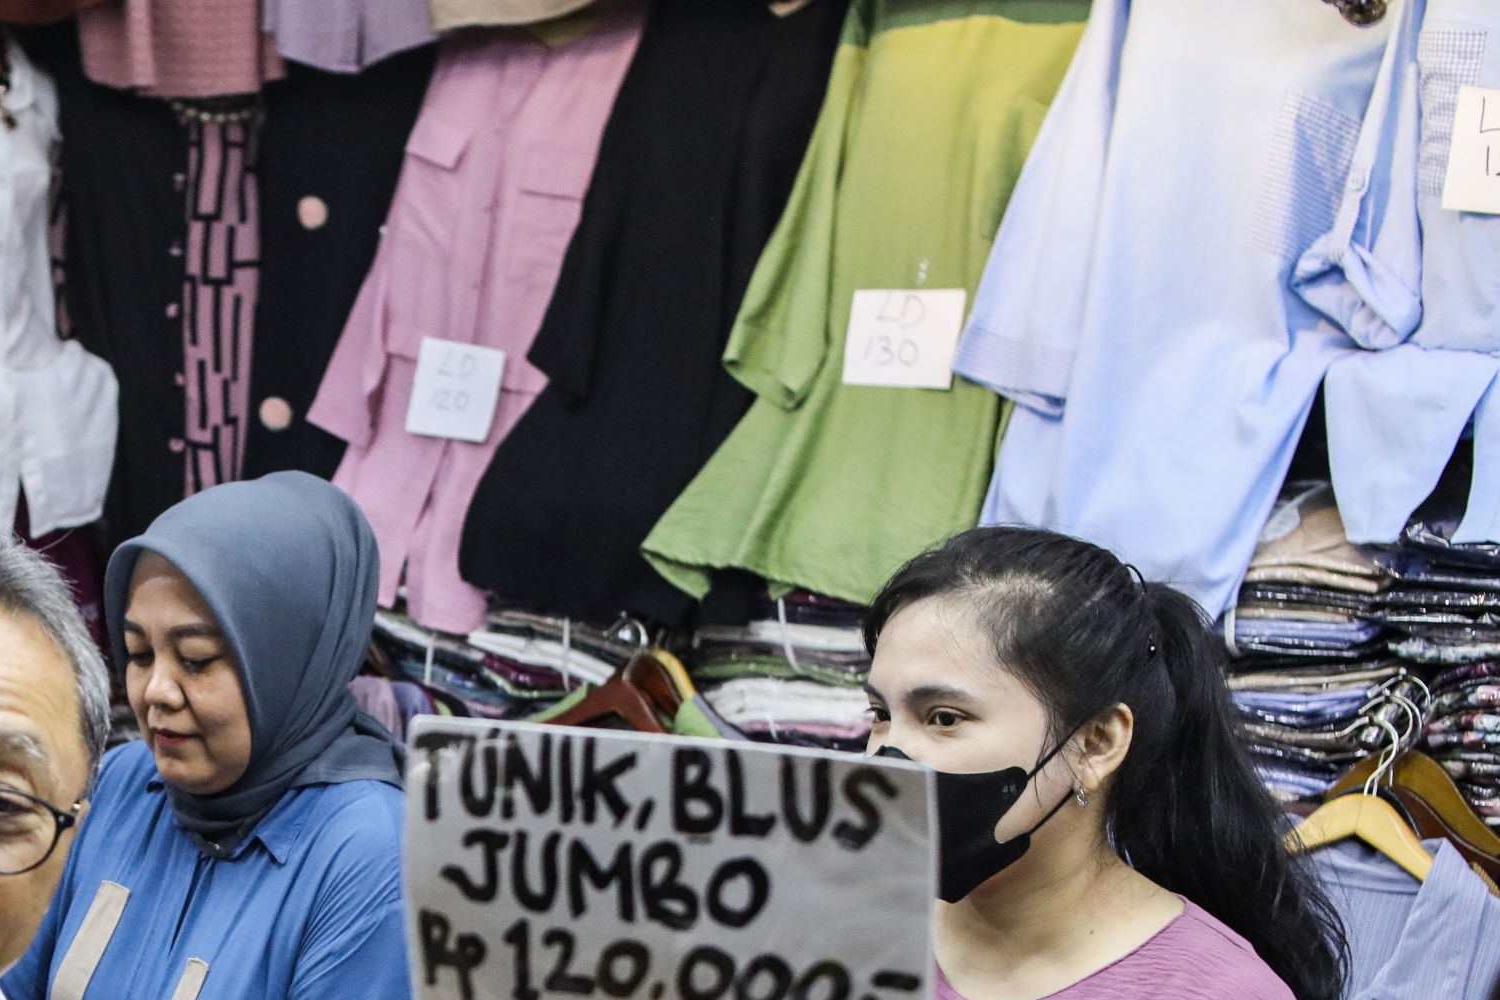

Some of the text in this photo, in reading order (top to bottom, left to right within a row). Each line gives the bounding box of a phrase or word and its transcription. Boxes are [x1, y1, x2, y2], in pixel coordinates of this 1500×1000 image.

[875, 291, 926, 330] LD
[863, 335, 920, 367] 130
[415, 729, 898, 851] TUNIK, BLUS
[441, 829, 770, 930] JUMBO
